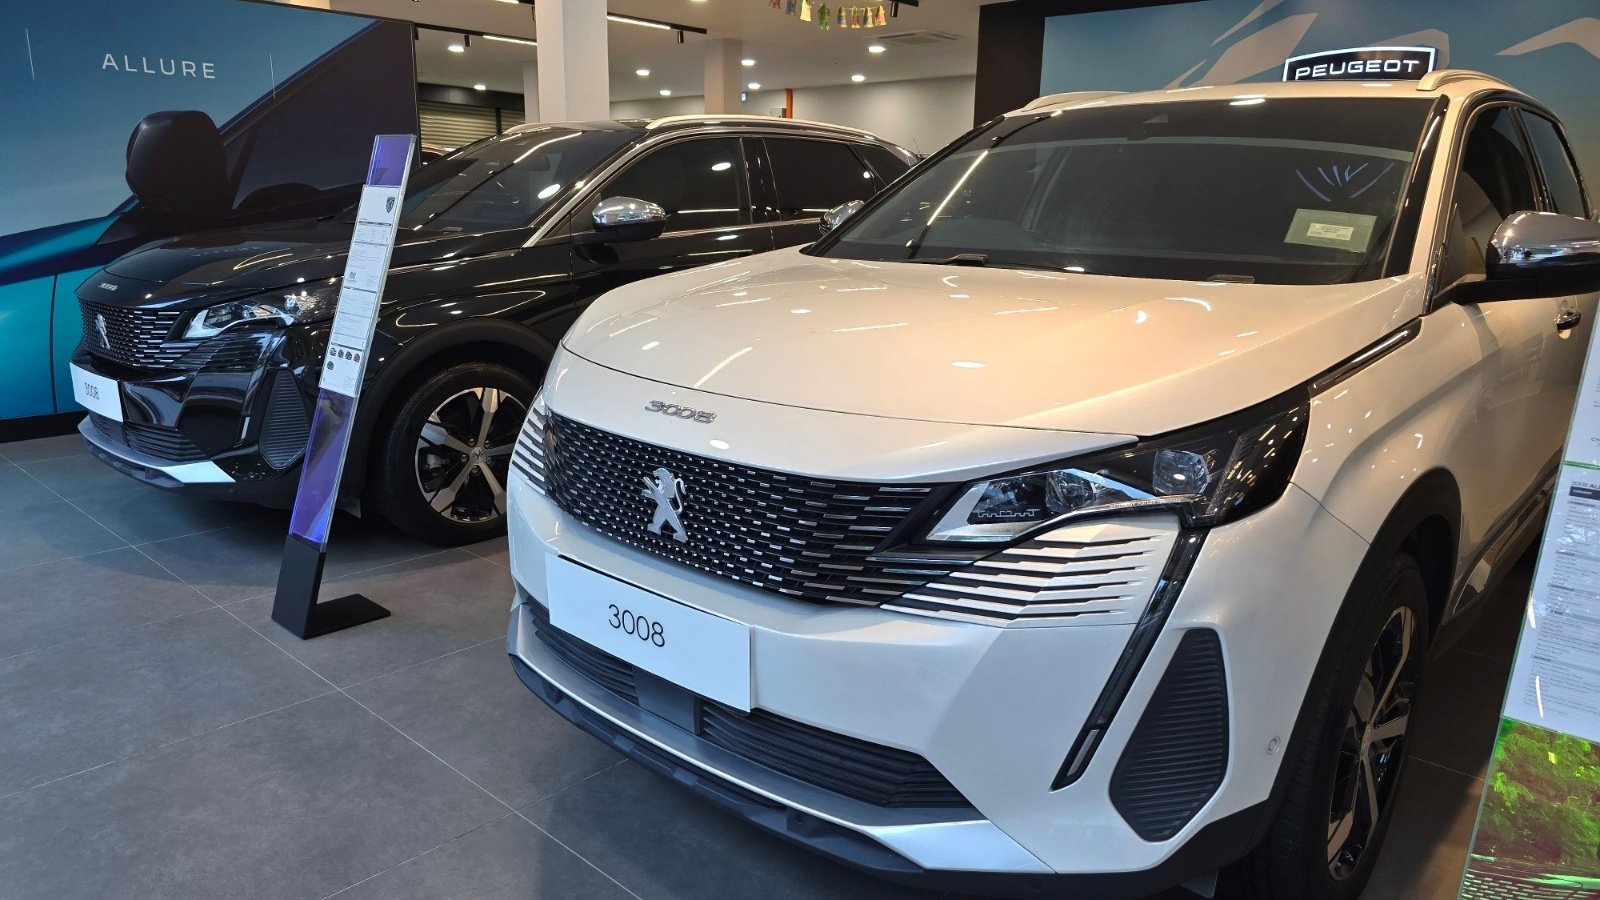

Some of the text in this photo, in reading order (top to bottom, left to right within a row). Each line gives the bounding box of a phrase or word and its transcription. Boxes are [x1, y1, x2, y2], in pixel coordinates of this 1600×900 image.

[102, 53, 216, 79] ALLURE
[1295, 59, 1420, 80] PEUGEOT
[84, 382, 100, 400] 3008
[644, 399, 717, 424] 3008
[608, 603, 666, 648] 3008
